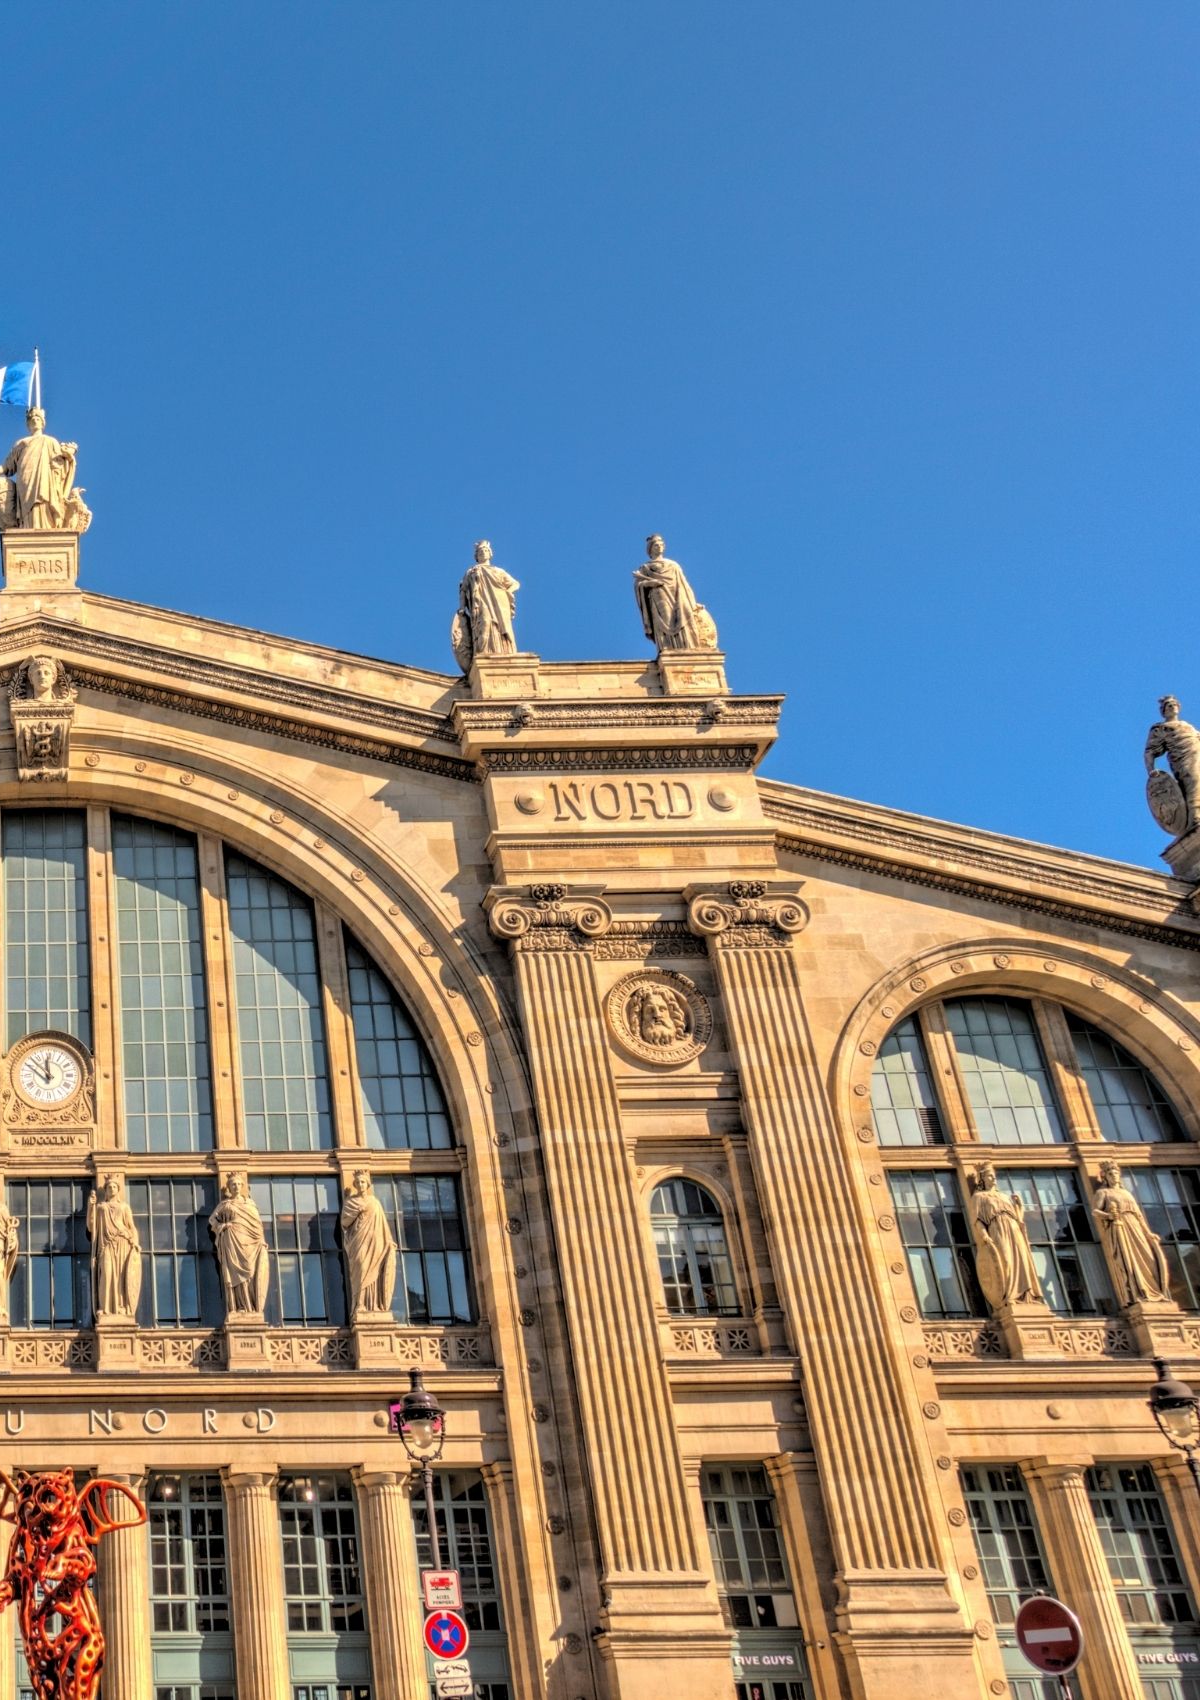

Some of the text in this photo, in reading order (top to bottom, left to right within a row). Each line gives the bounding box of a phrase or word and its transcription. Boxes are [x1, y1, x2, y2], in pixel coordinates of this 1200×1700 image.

[18, 559, 63, 574] PARIS
[548, 780, 694, 822] NORD
[88, 1408, 275, 1435] NORD
[734, 1655, 794, 1665] FIVE GUYS
[1138, 1652, 1199, 1663] FIVE GUYS
